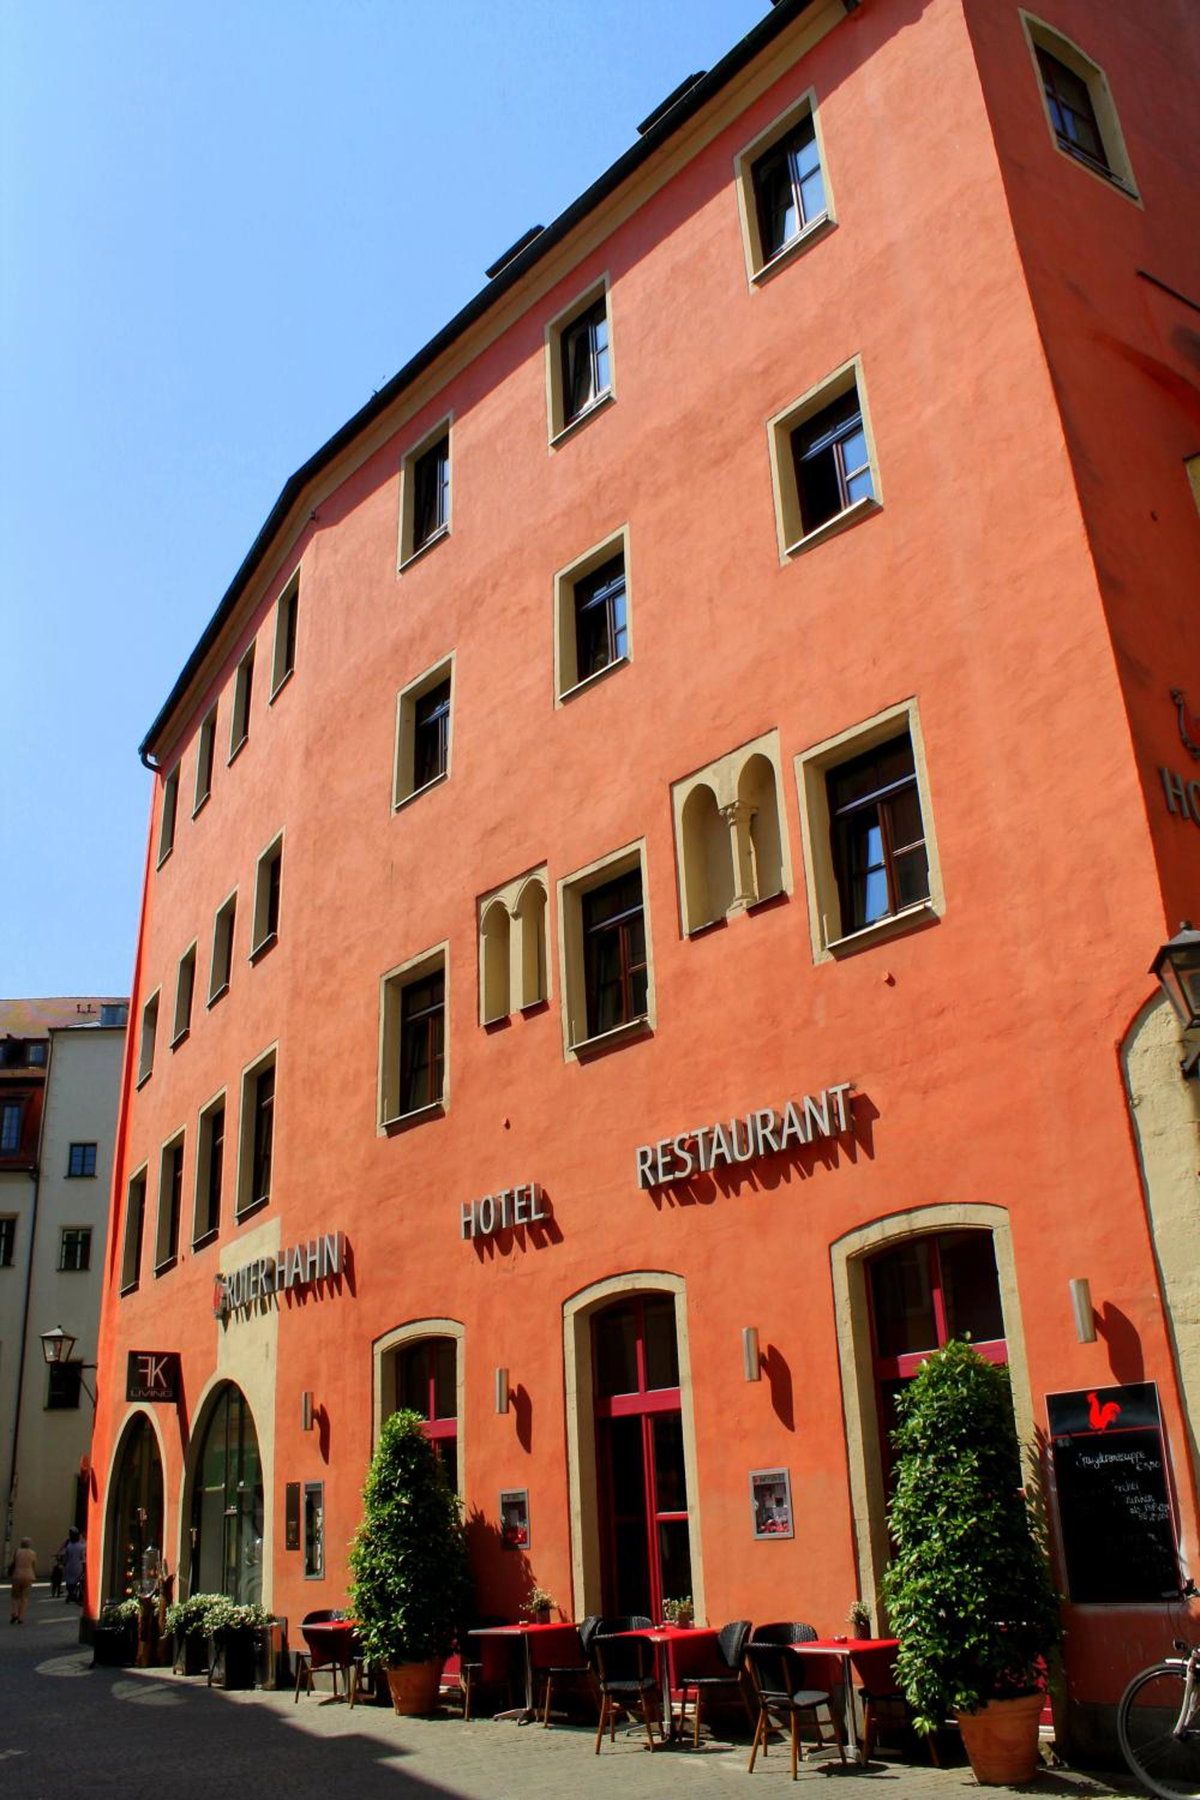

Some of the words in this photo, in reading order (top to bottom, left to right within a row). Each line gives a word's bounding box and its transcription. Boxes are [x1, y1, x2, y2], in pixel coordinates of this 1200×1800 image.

[636, 1082, 851, 1189] RESTAURANT
[460, 1182, 546, 1240] HOTEL
[225, 1257, 269, 1312] ROTER
[275, 1231, 341, 1290] HAHN
[130, 1389, 173, 1398] LIVING
